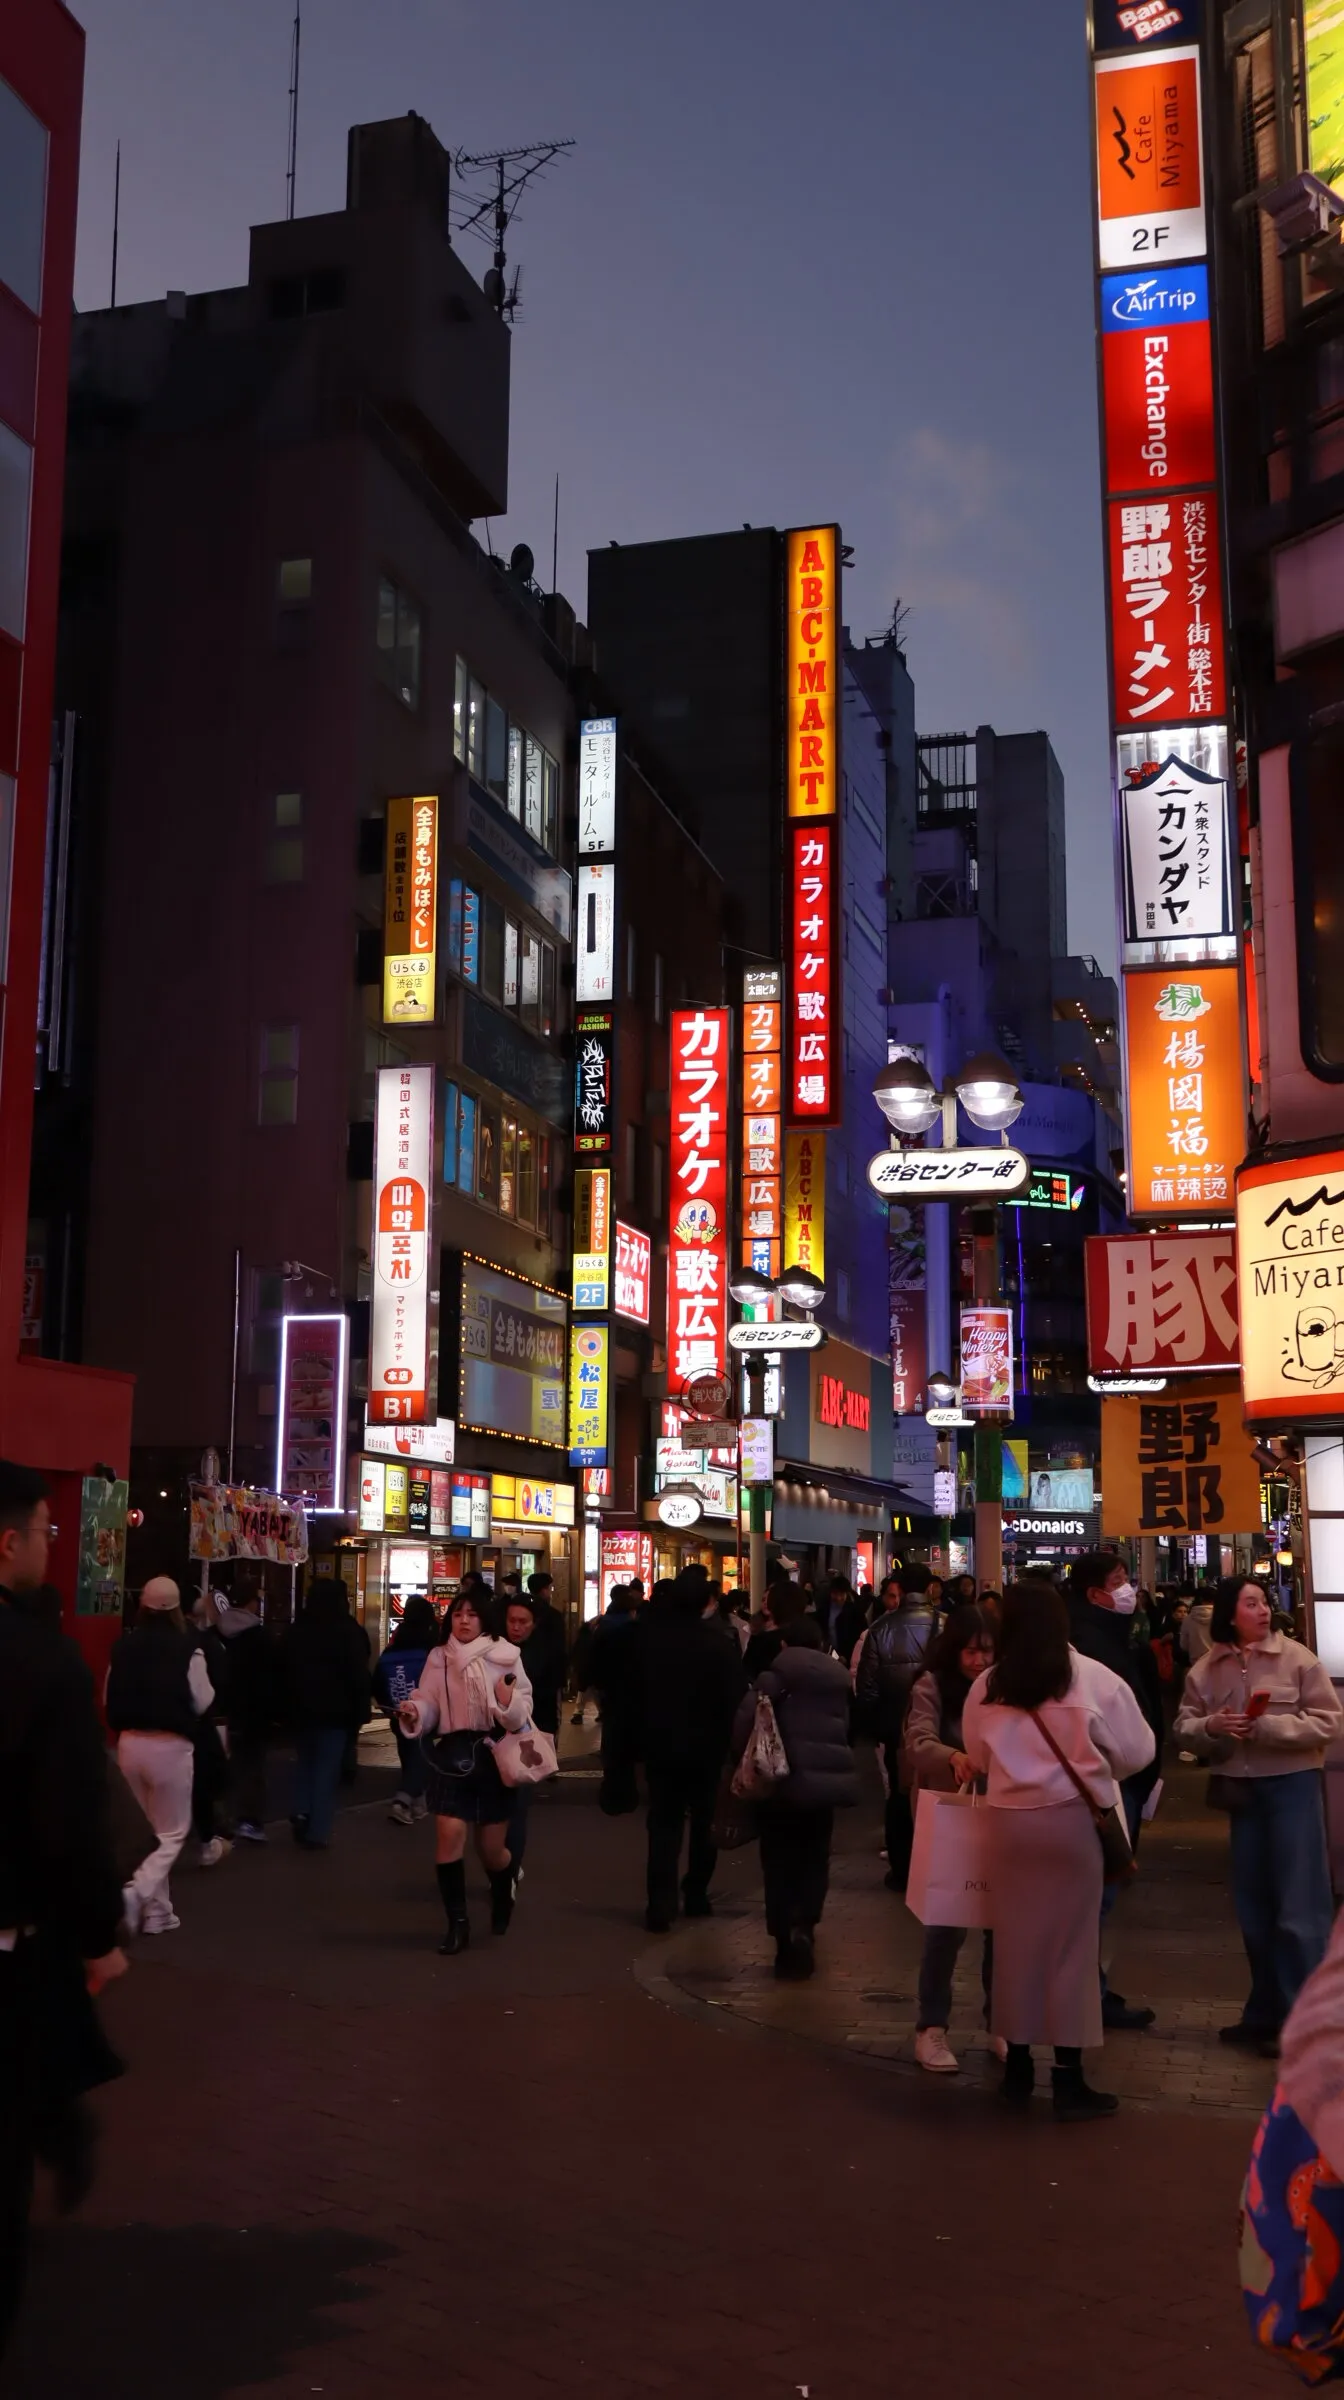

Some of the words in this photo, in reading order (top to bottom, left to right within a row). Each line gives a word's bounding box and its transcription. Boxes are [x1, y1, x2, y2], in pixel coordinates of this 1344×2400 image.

[1119, 0, 1166, 29] Ban
[1134, 11, 1181, 39] Ban
[1136, 113, 1152, 164] Cafe
[1161, 85, 1185, 188] Miyama
[1132, 226, 1170, 251] 2F
[1127, 288, 1196, 313] AirTrip
[1141, 336, 1170, 478] Exchange
[1183, 501, 1211, 645] 渋谷センター街
[1121, 503, 1174, 718] 野郎ラーメン
[1188, 649, 1213, 713] 総本店
[584, 738, 598, 836] モニタールーム
[588, 840, 605, 851] 5F
[1194, 801, 1211, 890] 大衆スタンド
[414, 806, 434, 949] 全身もみほぐし
[1157, 803, 1190, 925] カンダヤ
[394, 963, 426, 973] りらくる
[593, 977, 610, 989] 4F
[746, 972, 778, 981] センター街
[578, 1023, 611, 1032] FASHION
[584, 1015, 605, 1023] ROCK
[751, 1005, 774, 1108] カラオケ
[678, 1012, 721, 1195] カラオケ
[1163, 1029, 1209, 1156] 楊國福
[580, 1138, 606, 1150] 3F
[877, 1159, 1020, 1182] 渋谷センター街
[1152, 1162, 1225, 1176] マーラータン
[749, 1147, 775, 1236] 歌広場
[391, 1185, 413, 1280] 마약포차
[1282, 1218, 1344, 1251] Cafe
[577, 1258, 605, 1268] りらくる
[753, 1241, 771, 1277] 受付
[580, 1288, 603, 1303] 2F
[675, 1248, 720, 1383] 歌広場
[495, 1311, 563, 1370] 全身もみほぐし
[733, 1329, 816, 1343] 渋谷センター街
[970, 1327, 1008, 1347] Happy
[579, 1362, 601, 1410] 松屋
[692, 1387, 724, 1402] 消火栓
[384, 1397, 412, 1419] B1
[1138, 1401, 1224, 1531] 野郎
[603, 1537, 637, 1550] カラオケ
[603, 1553, 637, 1566] 歌広場
